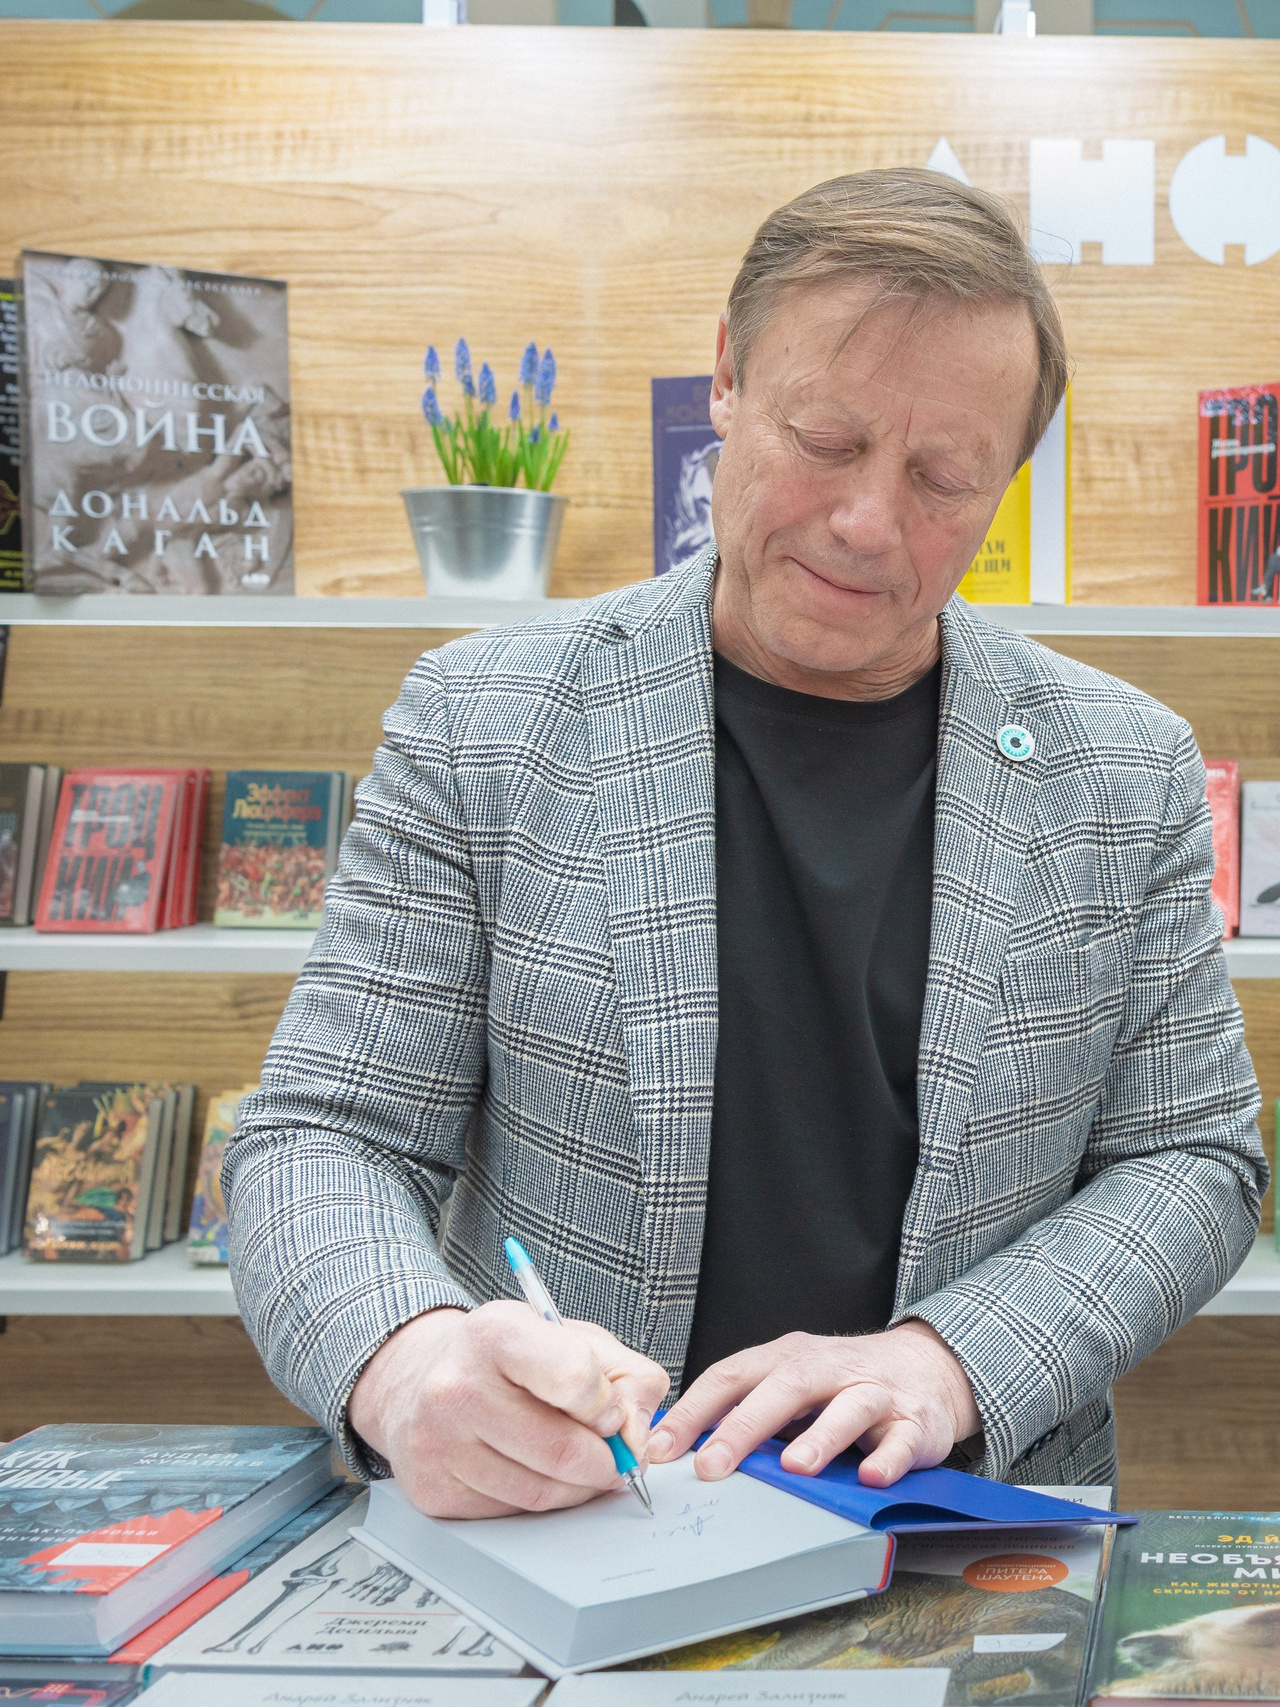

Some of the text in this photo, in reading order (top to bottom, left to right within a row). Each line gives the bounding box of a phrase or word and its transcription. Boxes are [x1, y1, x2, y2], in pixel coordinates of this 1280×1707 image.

[46, 398, 270, 459] ВОЙНА
[50, 490, 270, 528] ДОНАЛЬД
[52, 525, 270, 562] КАГАН
[0, 1450, 91, 1468] КАК
[1217, 1534, 1253, 1544] ЭД
[986, 1567, 1048, 1575] ПИТЕРА
[325, 1617, 428, 1628] Джереми
[315, 1627, 418, 1636] Десильва
